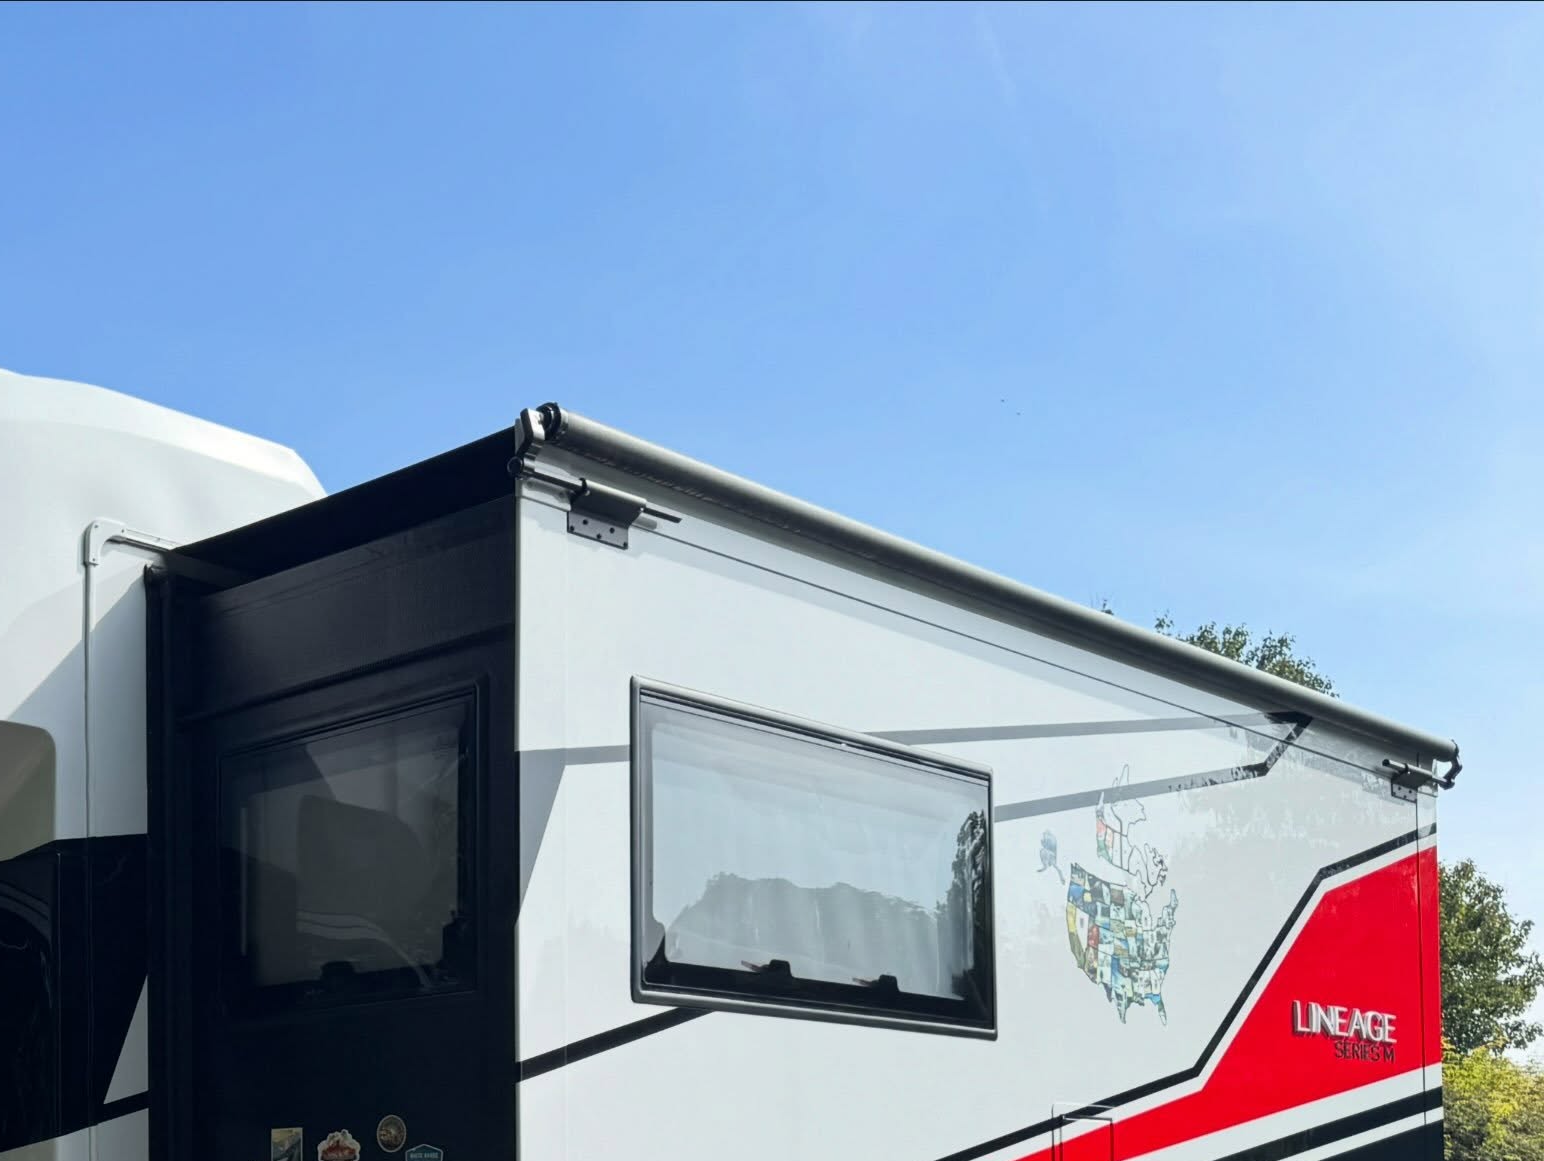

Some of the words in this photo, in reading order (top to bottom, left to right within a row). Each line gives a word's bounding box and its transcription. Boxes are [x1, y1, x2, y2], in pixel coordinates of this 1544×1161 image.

[1293, 1000, 1397, 1043] LINEAGE
[1335, 1041, 1380, 1061] SERIES
[1384, 1047, 1395, 1063] M
